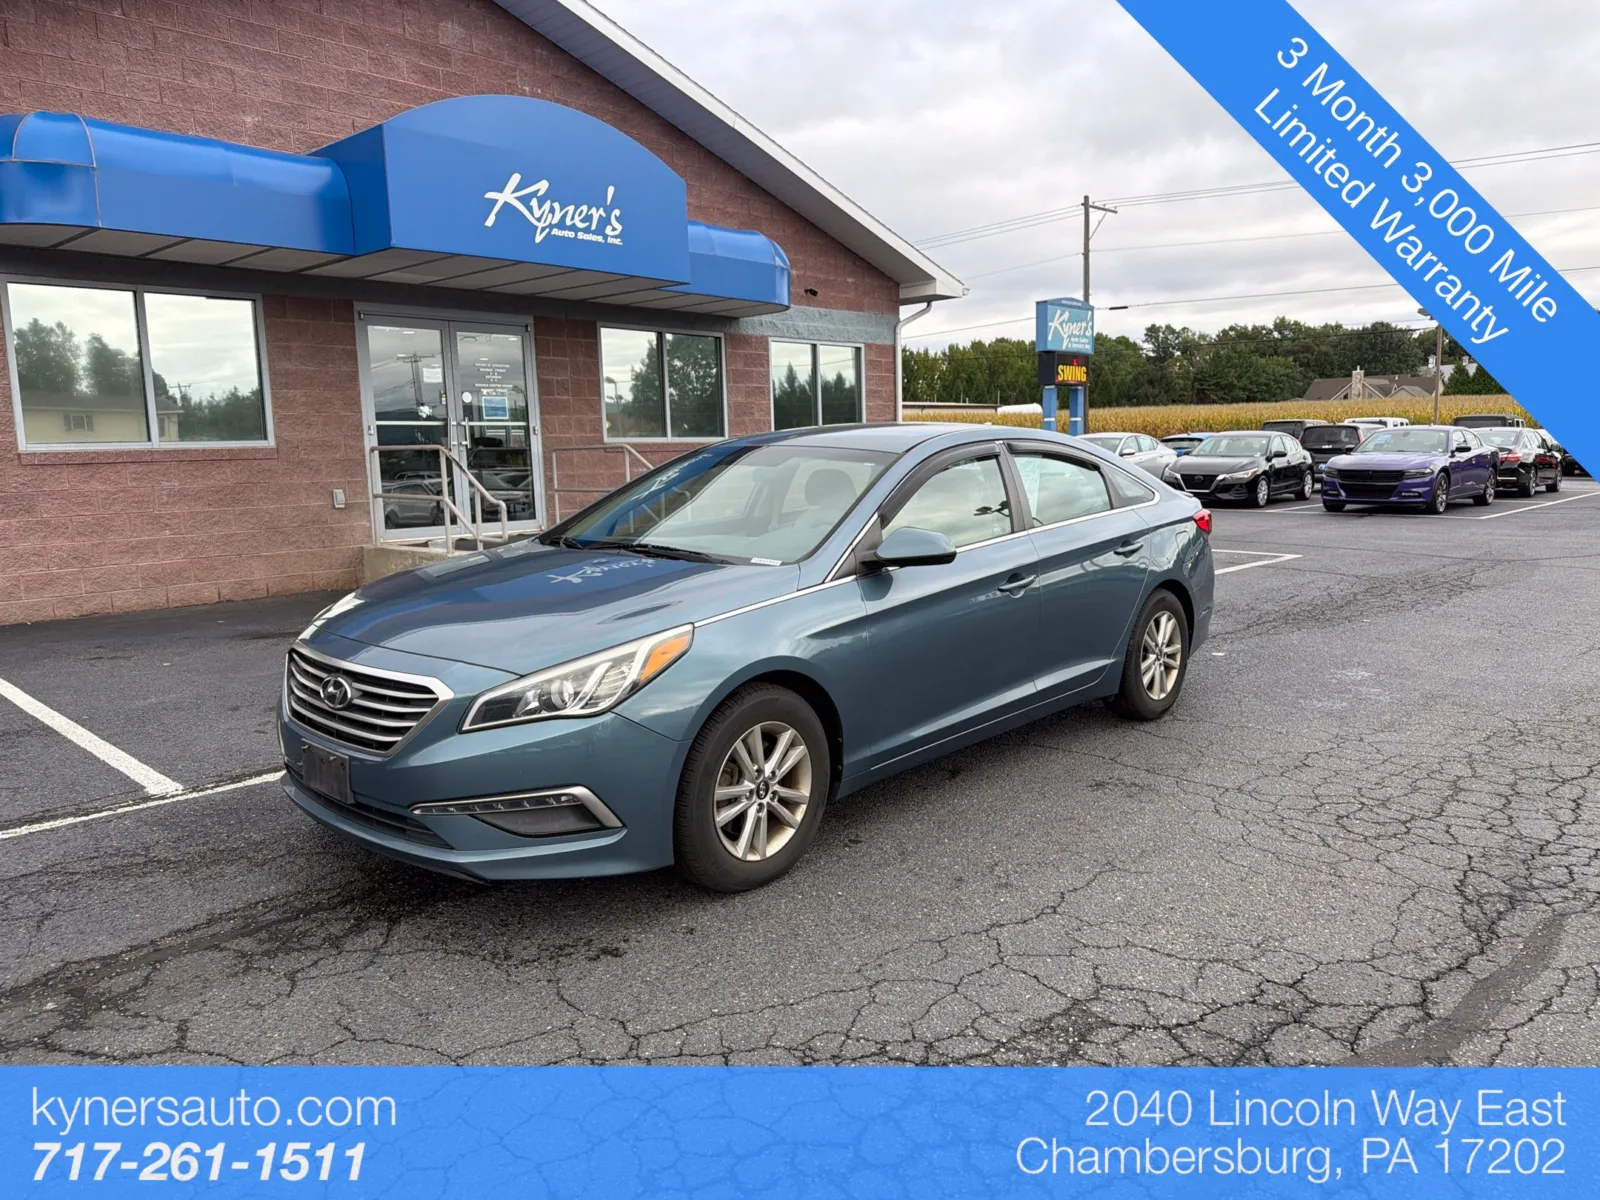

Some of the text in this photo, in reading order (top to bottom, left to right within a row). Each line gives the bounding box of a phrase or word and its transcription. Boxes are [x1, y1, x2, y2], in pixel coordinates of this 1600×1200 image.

[484, 172, 623, 243] Kyner's
[551, 228, 623, 245] Auto Sales, Inc.
[1048, 309, 1092, 350] Kyner's
[1057, 364, 1087, 382] SWING
